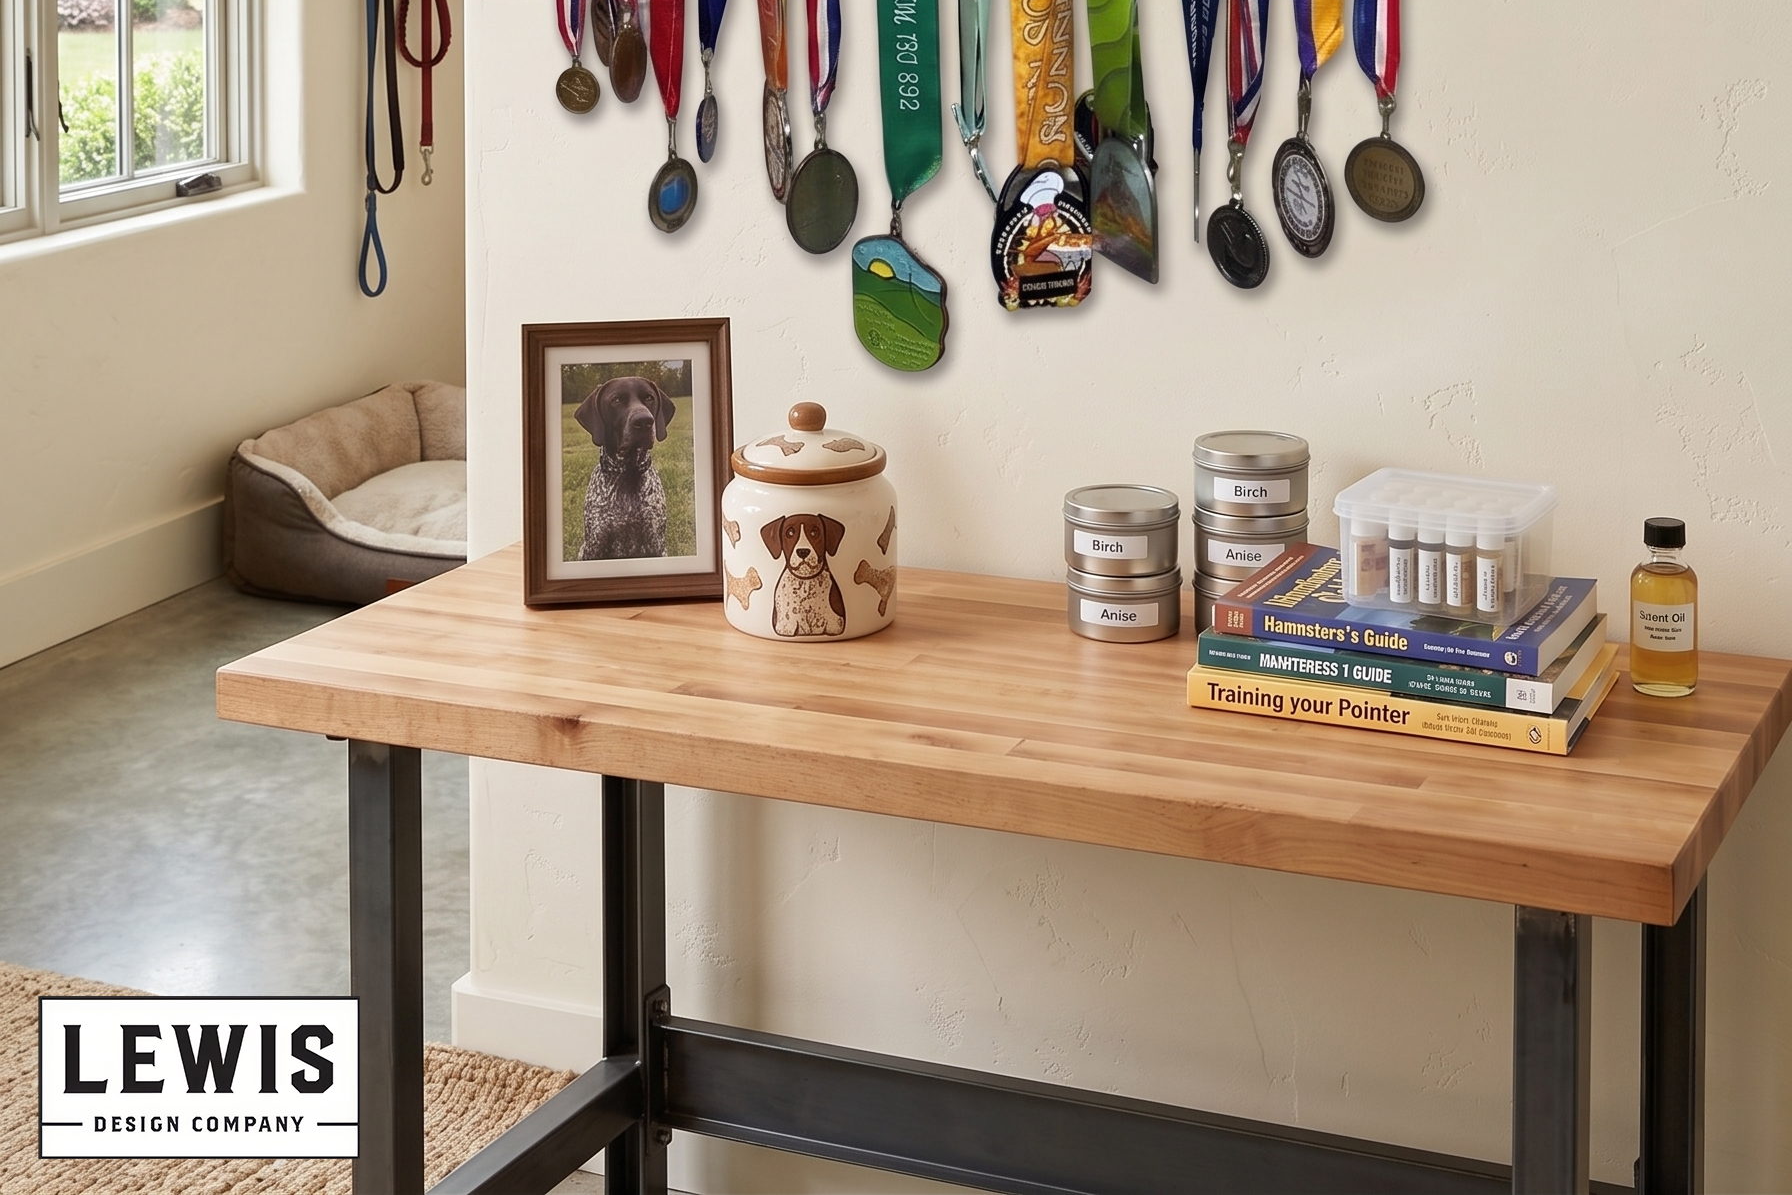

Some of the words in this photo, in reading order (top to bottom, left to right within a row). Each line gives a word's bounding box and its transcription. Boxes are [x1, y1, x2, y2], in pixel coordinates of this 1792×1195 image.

[898, 72, 920, 111] 892
[1234, 485, 1268, 498] Birch
[1092, 539, 1123, 553] Birch
[1225, 548, 1262, 562] Anise
[1100, 608, 1137, 622] Anise
[1671, 612, 1686, 623] Oil
[1364, 629, 1408, 651] Guide
[1352, 665, 1392, 684] GUIDE
[1207, 682, 1284, 713] Training
[1290, 695, 1333, 715] your
[1339, 697, 1410, 725] Pointer
